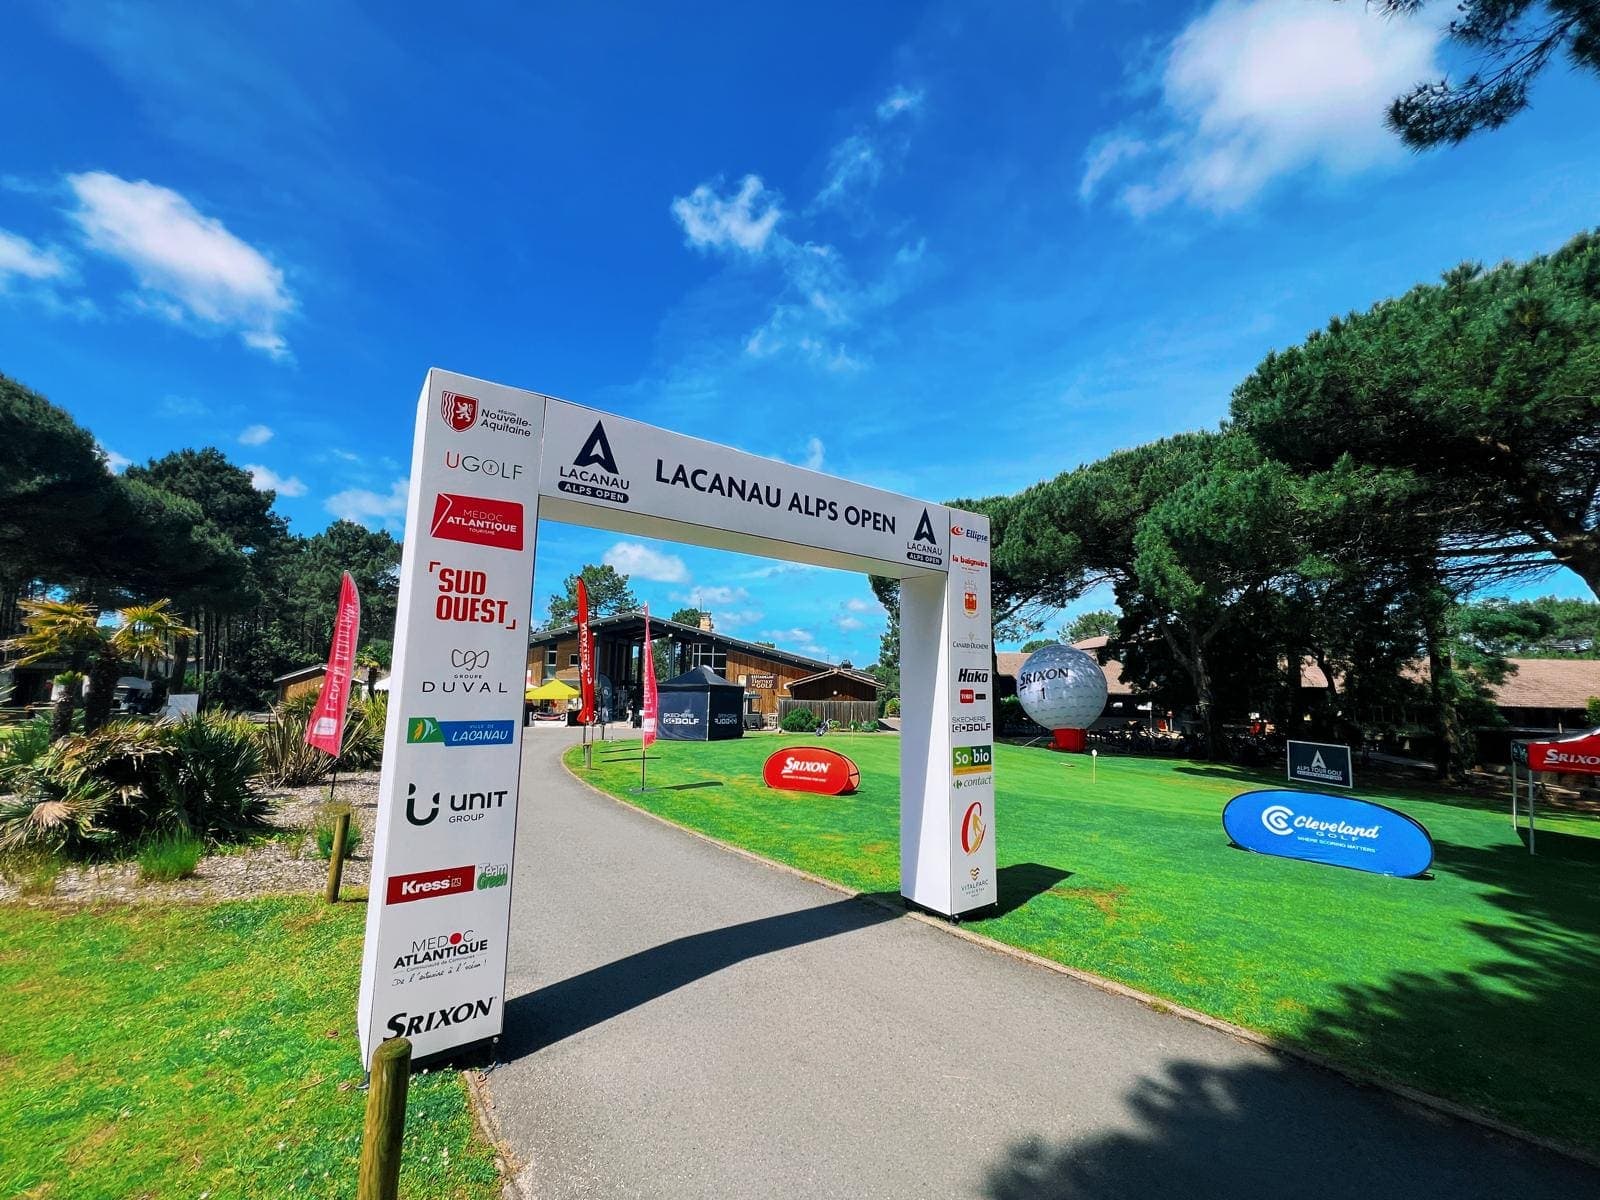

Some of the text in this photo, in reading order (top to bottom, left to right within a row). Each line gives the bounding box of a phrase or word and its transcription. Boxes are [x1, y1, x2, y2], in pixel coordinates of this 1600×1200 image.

[481, 409, 532, 427] Nouvelle-
[480, 419, 531, 437] Aquitaine
[446, 451, 523, 480] UGOLF
[560, 466, 630, 490] LACANAU
[564, 483, 624, 502] ALPS OPEN
[655, 458, 896, 535] LACANAU ALPS OPEN
[446, 515, 518, 533] ATLANTIQUE
[906, 541, 943, 556] LACANAU
[438, 567, 487, 596] SUD
[436, 595, 509, 624] OUEST
[958, 668, 989, 683] Hako
[1020, 667, 1069, 690] SRIXON
[422, 681, 508, 693] DUVAL
[452, 730, 509, 742] LACANAU
[781, 756, 829, 774] SRIXON
[955, 748, 990, 765] So bio
[964, 776, 992, 788] contact
[448, 813, 485, 824] GROUP
[1293, 815, 1381, 839] Cleveland
[1297, 836, 1318, 844] WHERE
[1315, 831, 1360, 842] GOLF
[401, 878, 451, 896] Kress
[393, 939, 488, 970] ATLANTIQUE
[384, 997, 496, 1041] SRIXON
